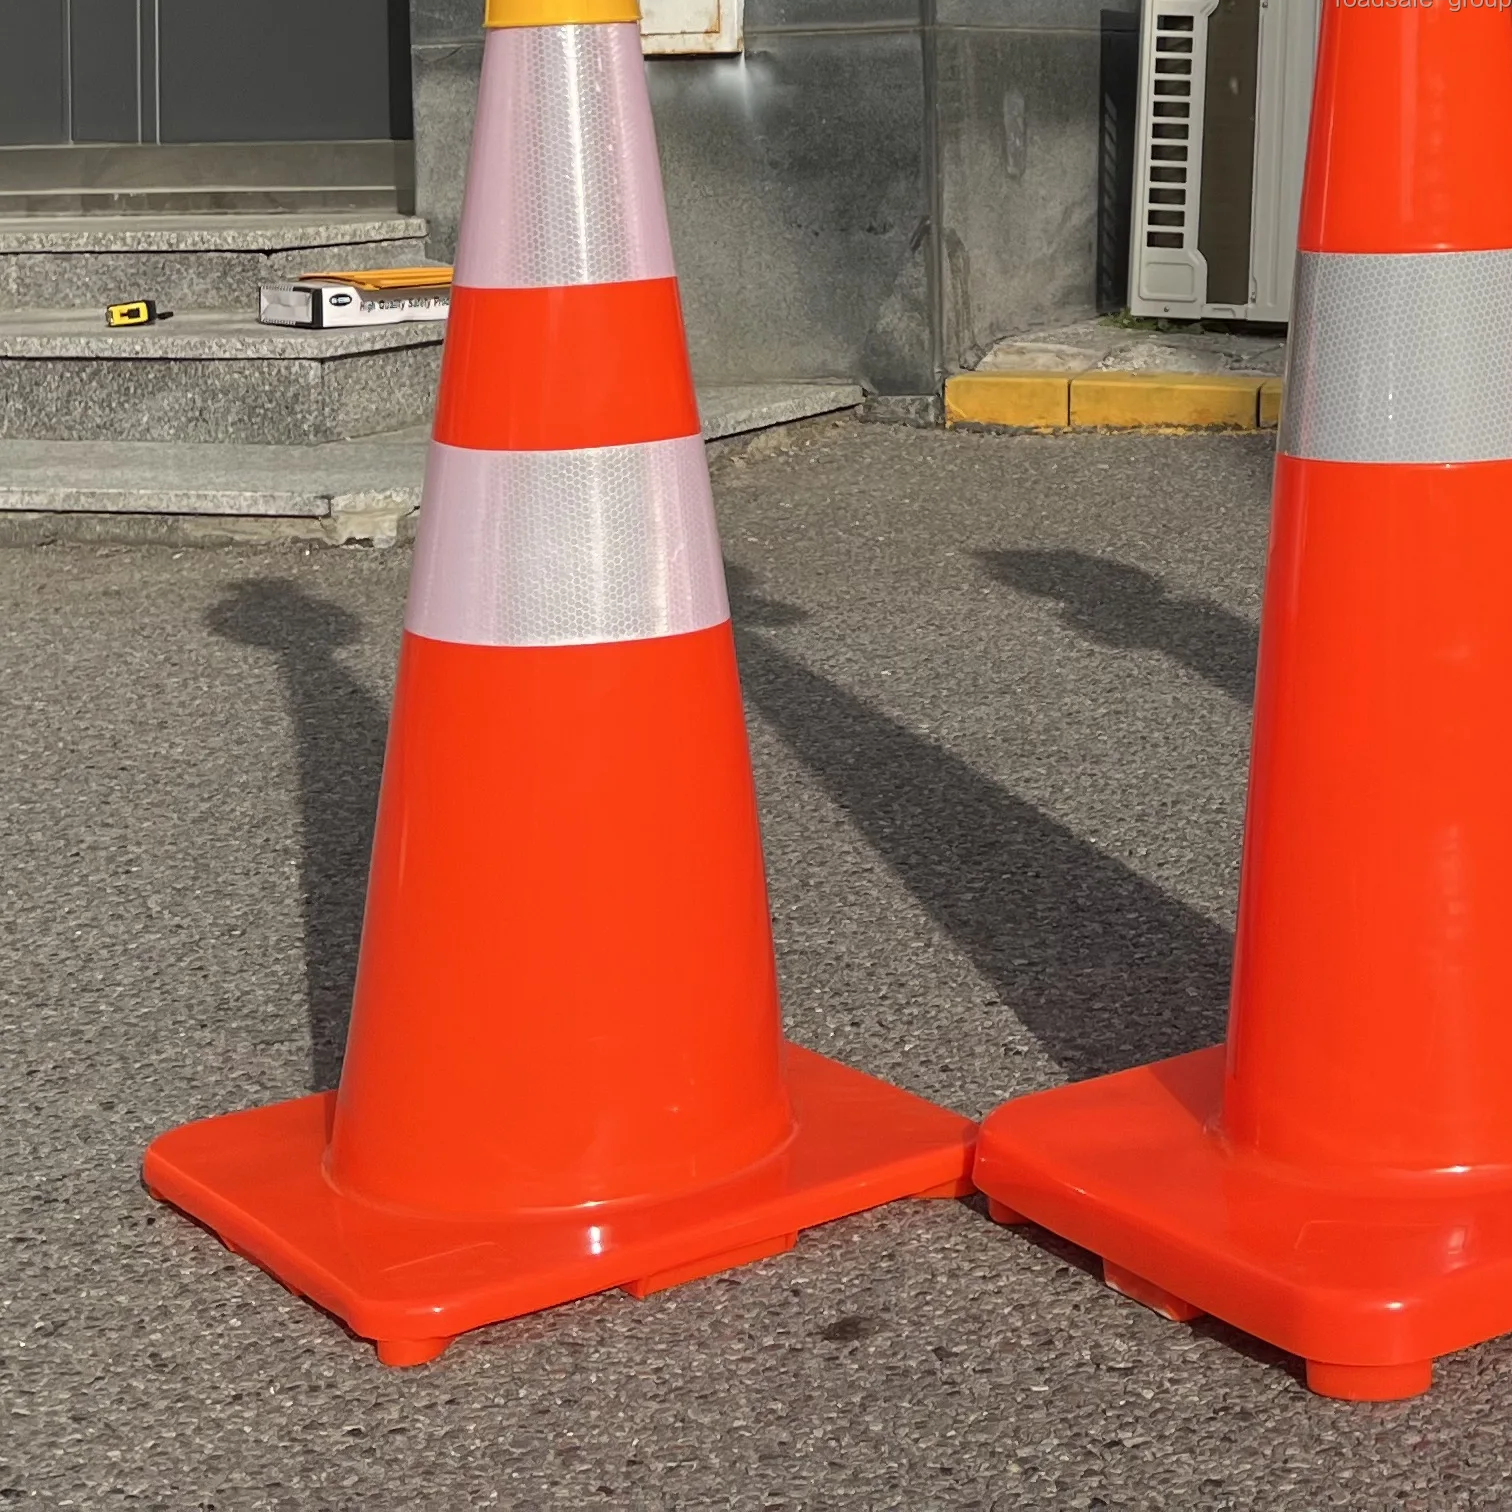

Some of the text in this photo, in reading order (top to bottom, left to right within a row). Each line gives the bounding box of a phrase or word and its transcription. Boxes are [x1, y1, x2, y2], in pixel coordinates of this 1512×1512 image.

[360, 301, 376, 313] High
[379, 299, 405, 311] Quality
[408, 297, 431, 310] Safety
